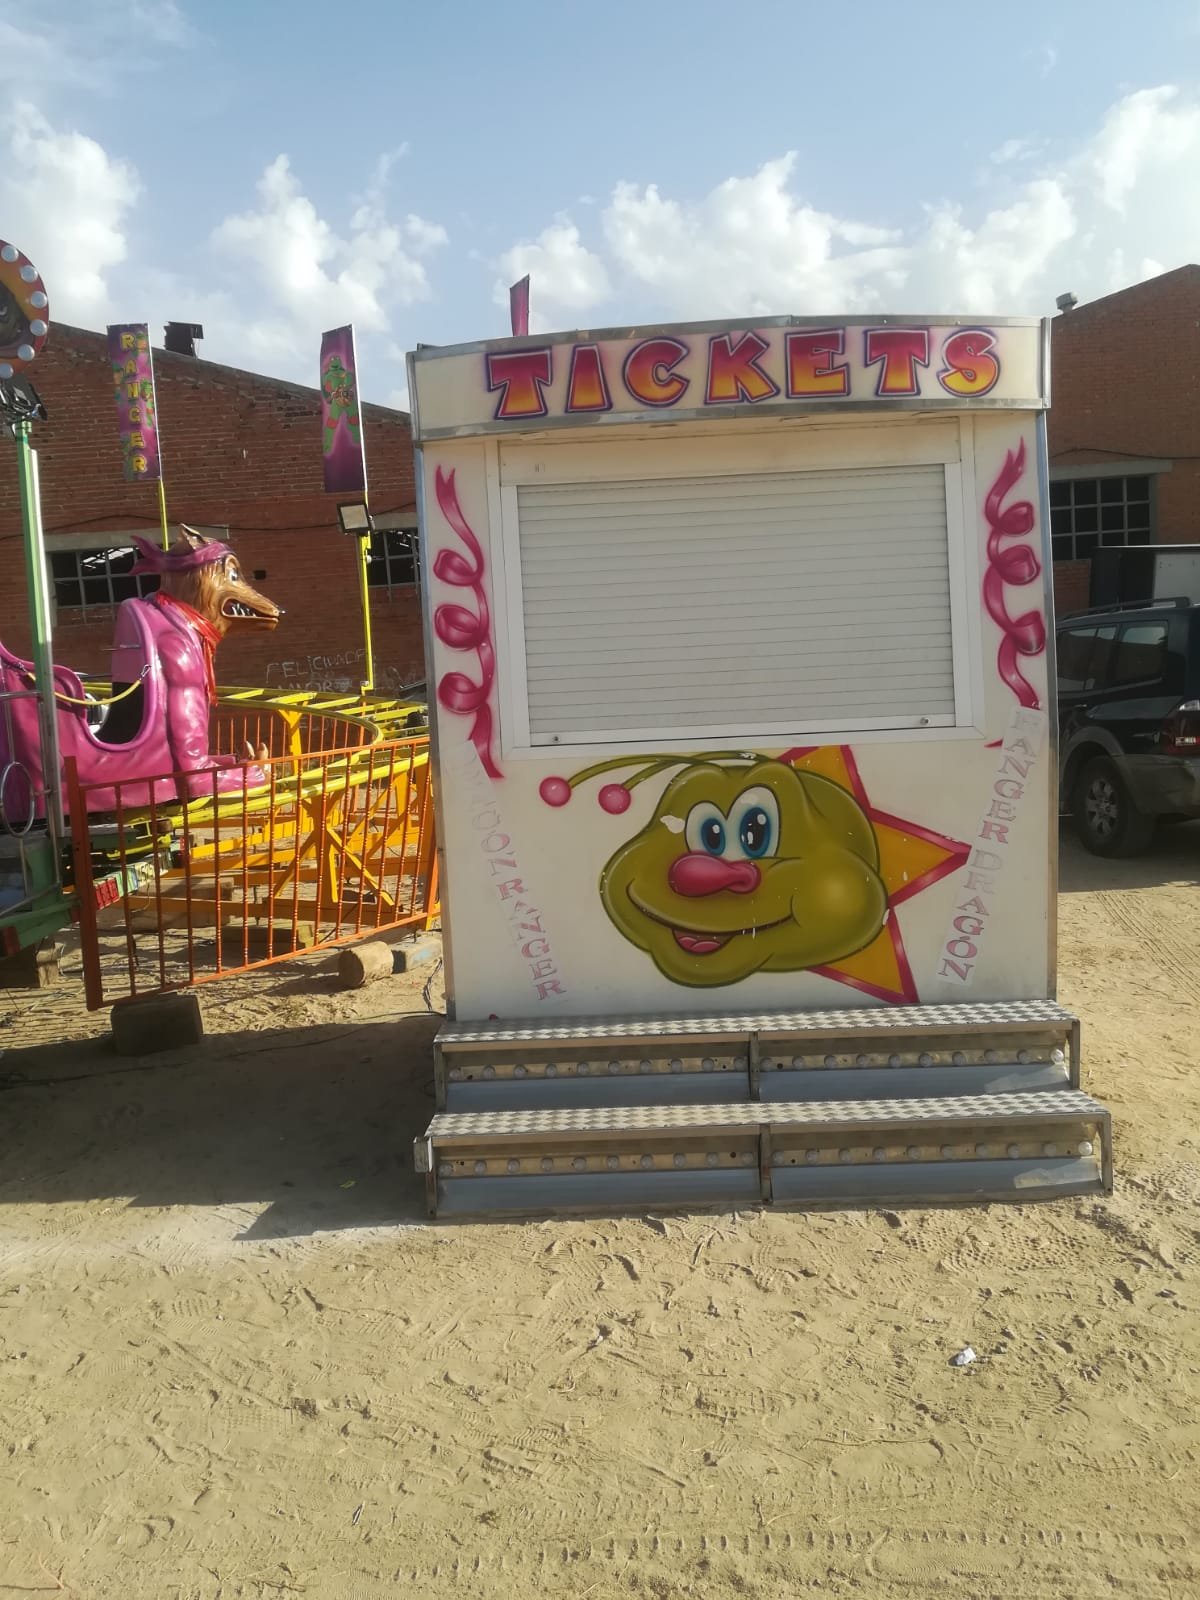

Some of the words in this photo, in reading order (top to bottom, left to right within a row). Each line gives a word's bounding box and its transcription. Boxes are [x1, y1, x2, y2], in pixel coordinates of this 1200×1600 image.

[120, 331, 148, 474] RANGER
[484, 326, 1001, 421] TICKETS
[977, 710, 1041, 845] RANGER
